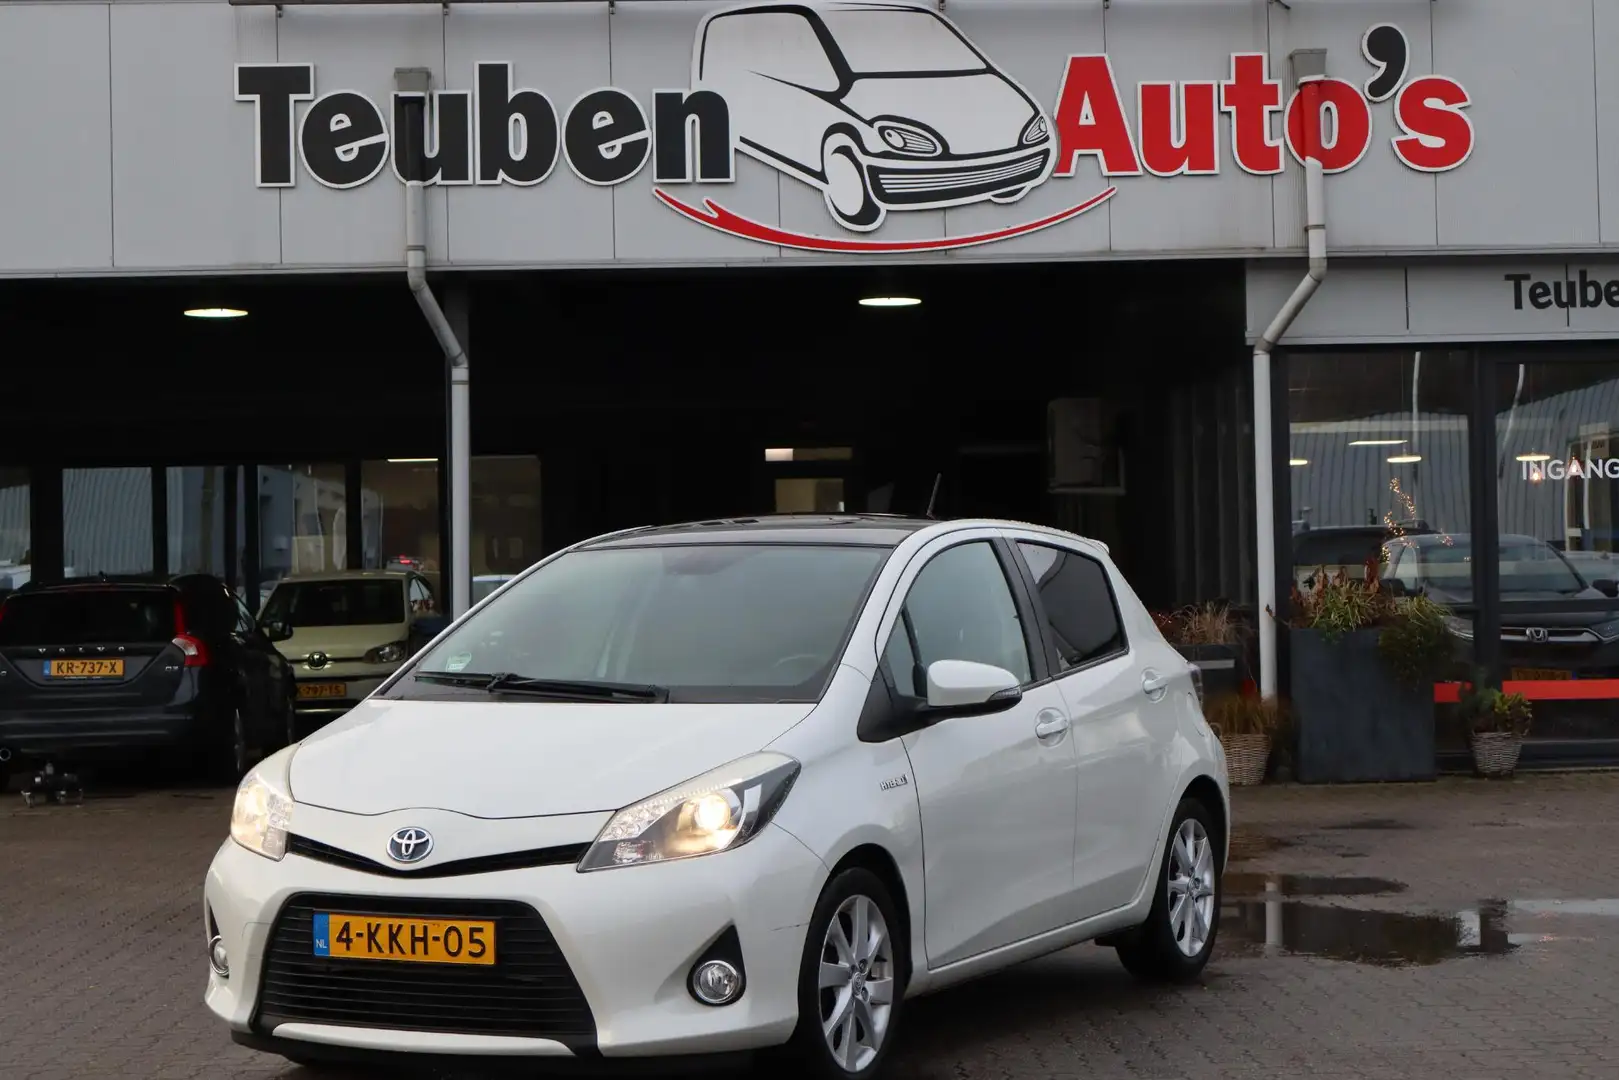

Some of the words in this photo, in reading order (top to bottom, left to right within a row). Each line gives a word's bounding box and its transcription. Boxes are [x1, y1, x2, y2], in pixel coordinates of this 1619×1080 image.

[236, 61, 734, 188] Teuben
[1054, 23, 1473, 175] Auto's
[1521, 458, 1619, 481] INGANG
[56, 661, 117, 674] KR-737-X
[316, 938, 327, 949] NL
[335, 921, 487, 959] 4-KKH-05
